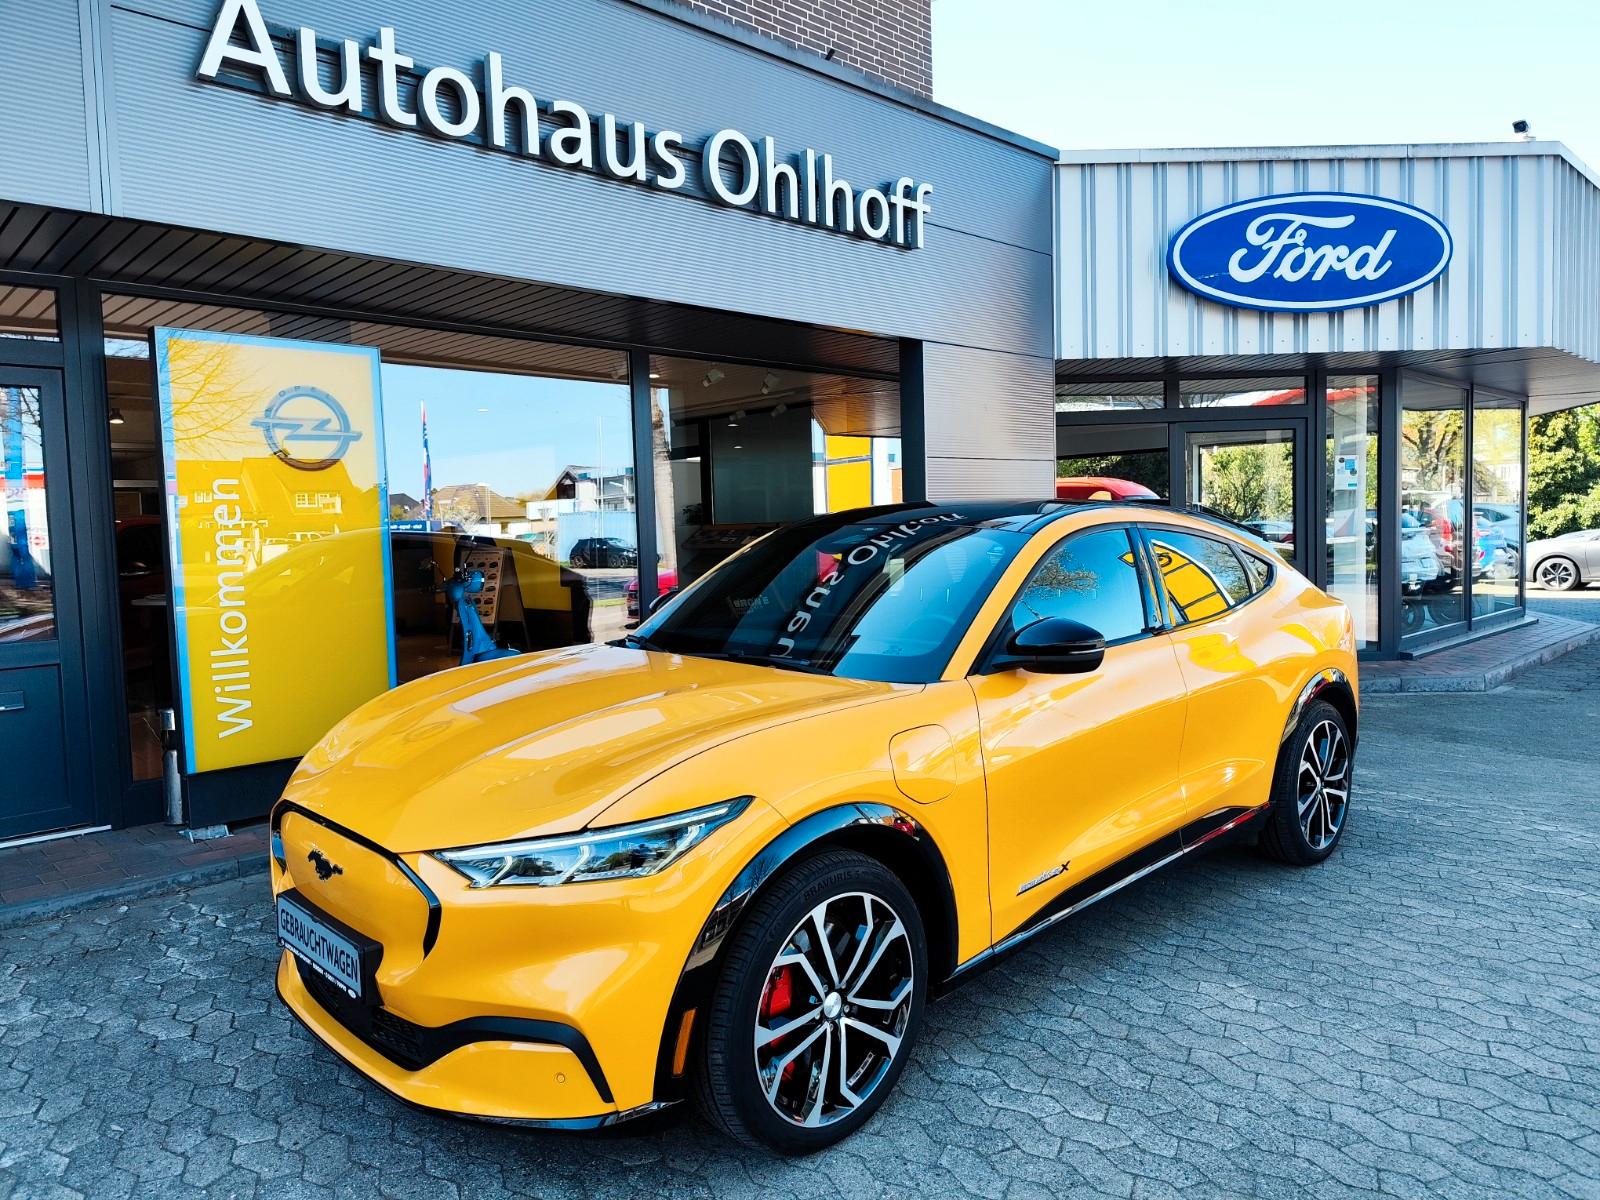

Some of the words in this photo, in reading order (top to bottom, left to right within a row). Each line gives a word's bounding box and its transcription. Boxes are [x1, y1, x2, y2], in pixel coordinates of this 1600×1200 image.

[197, 0, 686, 189] Autohaus
[704, 128, 933, 249] Ohlhoff
[1228, 213, 1397, 283] Ford
[209, 478, 254, 739] Willkommen
[280, 908, 358, 982] GEBRAUCHTWAGEN
